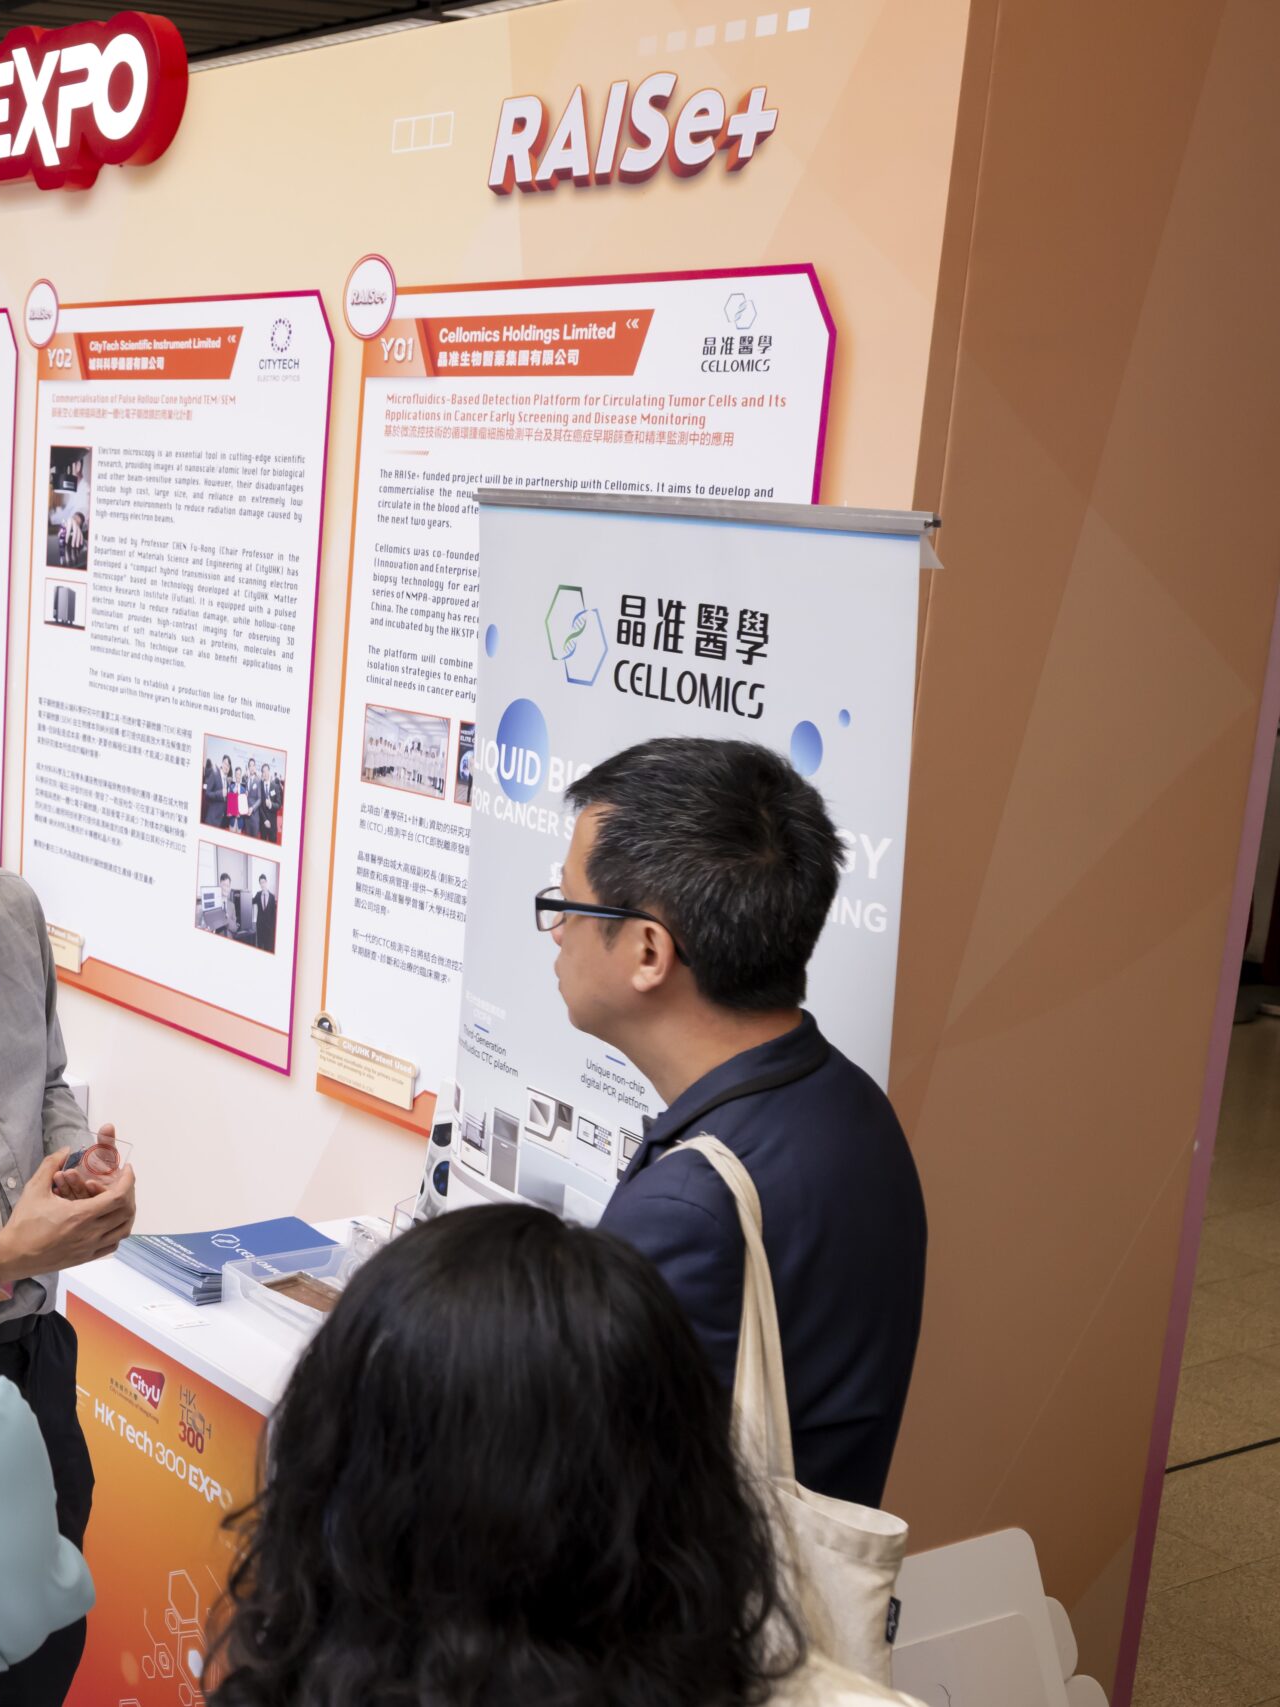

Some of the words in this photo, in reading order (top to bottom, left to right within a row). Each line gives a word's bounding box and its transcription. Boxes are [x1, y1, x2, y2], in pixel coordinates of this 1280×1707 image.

[488, 71, 778, 192] RAISe+
[439, 328, 500, 344] Cellomics
[503, 325, 560, 344] Holdings
[563, 322, 616, 340] Limited
[120, 339, 152, 351] Scientific
[153, 338, 192, 350] Instrument
[193, 337, 221, 349] Limited
[381, 337, 414, 362] Y01
[701, 335, 773, 356] 晶准醫學
[47, 348, 72, 369] Y02
[259, 358, 300, 371] CITYTECH
[700, 359, 771, 373] CELLOMICS
[387, 394, 480, 410] Microfluidics-Based
[483, 394, 531, 405] Detection
[534, 394, 580, 405] Platform
[585, 395, 601, 405] for
[603, 395, 665, 410] Circulating
[669, 395, 706, 406] Tumor
[709, 395, 737, 407] Cells
[741, 395, 764, 407] and
[769, 395, 786, 407] Its
[385, 410, 440, 425] Applications
[443, 413, 452, 421] in
[455, 411, 488, 421] Cancer
[490, 411, 515, 425] Early
[519, 412, 569, 426] Screening
[572, 412, 591, 423] and
[595, 412, 637, 424] Disease
[641, 414, 706, 429] Monitoring
[379, 486, 434, 496] commercialise
[440, 488, 452, 497] the
[381, 469, 392, 478] The
[423, 472, 450, 481] funded
[452, 475, 482, 484] project
[485, 475, 500, 489] will
[503, 476, 513, 489] be
[516, 478, 523, 490] in
[526, 477, 578, 492] partnership
[581, 480, 601, 493] with
[605, 480, 652, 496] Cellomics.
[657, 482, 664, 496] It
[668, 485, 691, 497] aims
[696, 484, 705, 494] to
[709, 485, 750, 498] develop
[754, 488, 774, 497] and
[378, 500, 411, 509] circulate
[423, 502, 435, 511] the
[438, 503, 459, 513] blood
[462, 504, 480, 516] afte
[378, 514, 389, 523] the
[391, 516, 408, 524] next
[411, 517, 425, 525] two
[428, 520, 451, 529] years.
[375, 543, 410, 554] Cellomics
[433, 550, 480, 561] co-founded
[420, 564, 434, 572] and
[373, 573, 397, 586] biopsy
[402, 576, 444, 591] technology
[448, 581, 460, 590] for
[464, 584, 480, 592] earl
[373, 589, 394, 598] series
[396, 605, 408, 614] The
[411, 609, 445, 622] company
[448, 612, 461, 621] has
[385, 620, 423, 631] incubated
[425, 624, 434, 635] by
[437, 626, 449, 635] the
[616, 594, 770, 666] 晶准醫學
[369, 645, 380, 654] The
[384, 649, 417, 660] platform
[422, 655, 436, 663] will
[440, 658, 473, 669] combine
[367, 661, 399, 672] isolation
[402, 666, 441, 680] strategies
[444, 672, 451, 681] to
[366, 675, 392, 685] clinical
[394, 680, 416, 690] needs
[427, 686, 454, 696] cancer
[455, 691, 476, 703] early
[613, 659, 766, 720] CELLOMICS
[494, 795, 559, 837] CANCER
[481, 1051, 493, 1065] CTC
[586, 1058, 611, 1078] Unique
[612, 1073, 646, 1096] non-chip
[580, 1073, 601, 1091] digital
[603, 1083, 617, 1098] PCR
[618, 1092, 649, 1113] platform
[130, 1372, 160, 1402] CityU
[95, 1398, 115, 1431] HK
[118, 1415, 153, 1457] Tech
[155, 1442, 187, 1479] 300
[178, 1421, 204, 1454] 300
